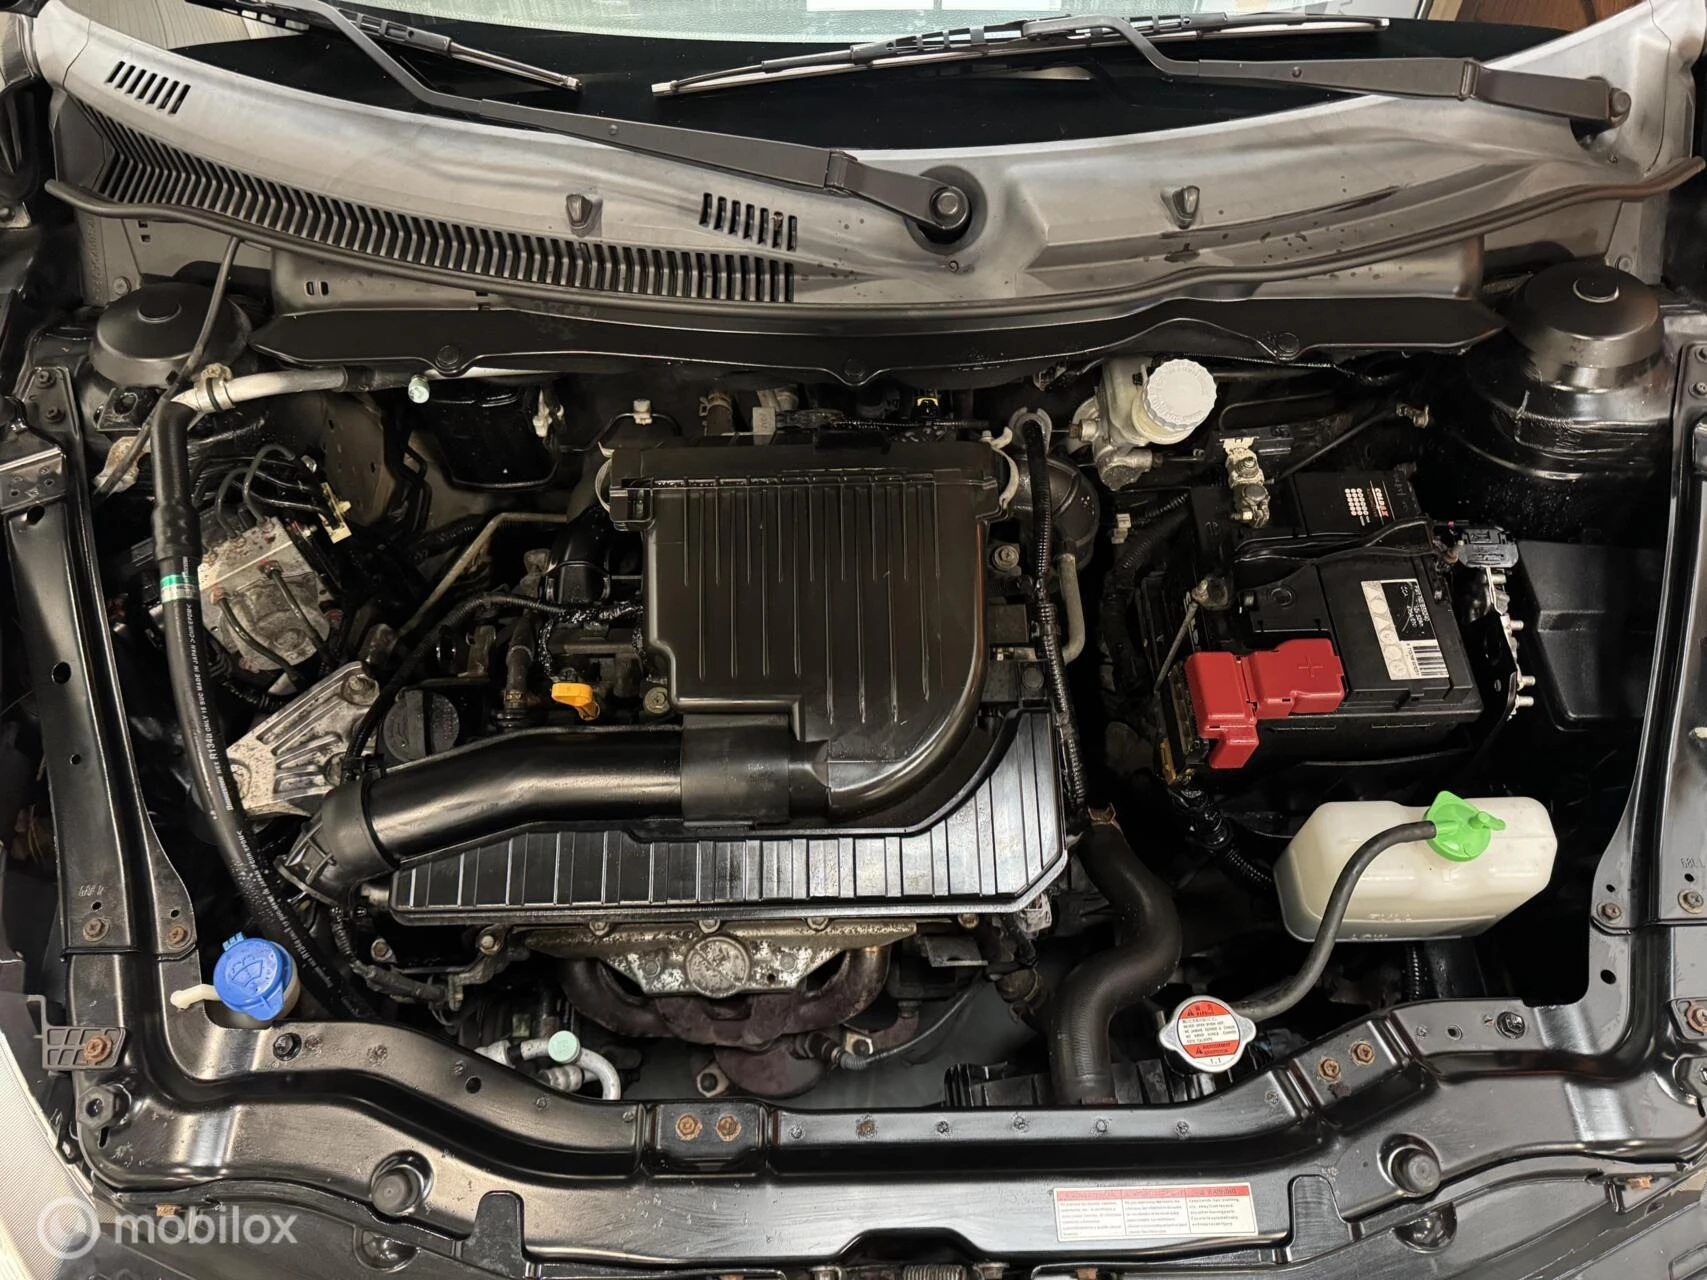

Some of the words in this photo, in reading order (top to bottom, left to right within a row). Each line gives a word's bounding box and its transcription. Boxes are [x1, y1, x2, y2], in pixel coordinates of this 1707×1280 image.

[190, 644, 199, 665] JAPAN
[193, 665, 200, 673] IN
[194, 673, 203, 691] MADE
[202, 715, 212, 732] ONLY
